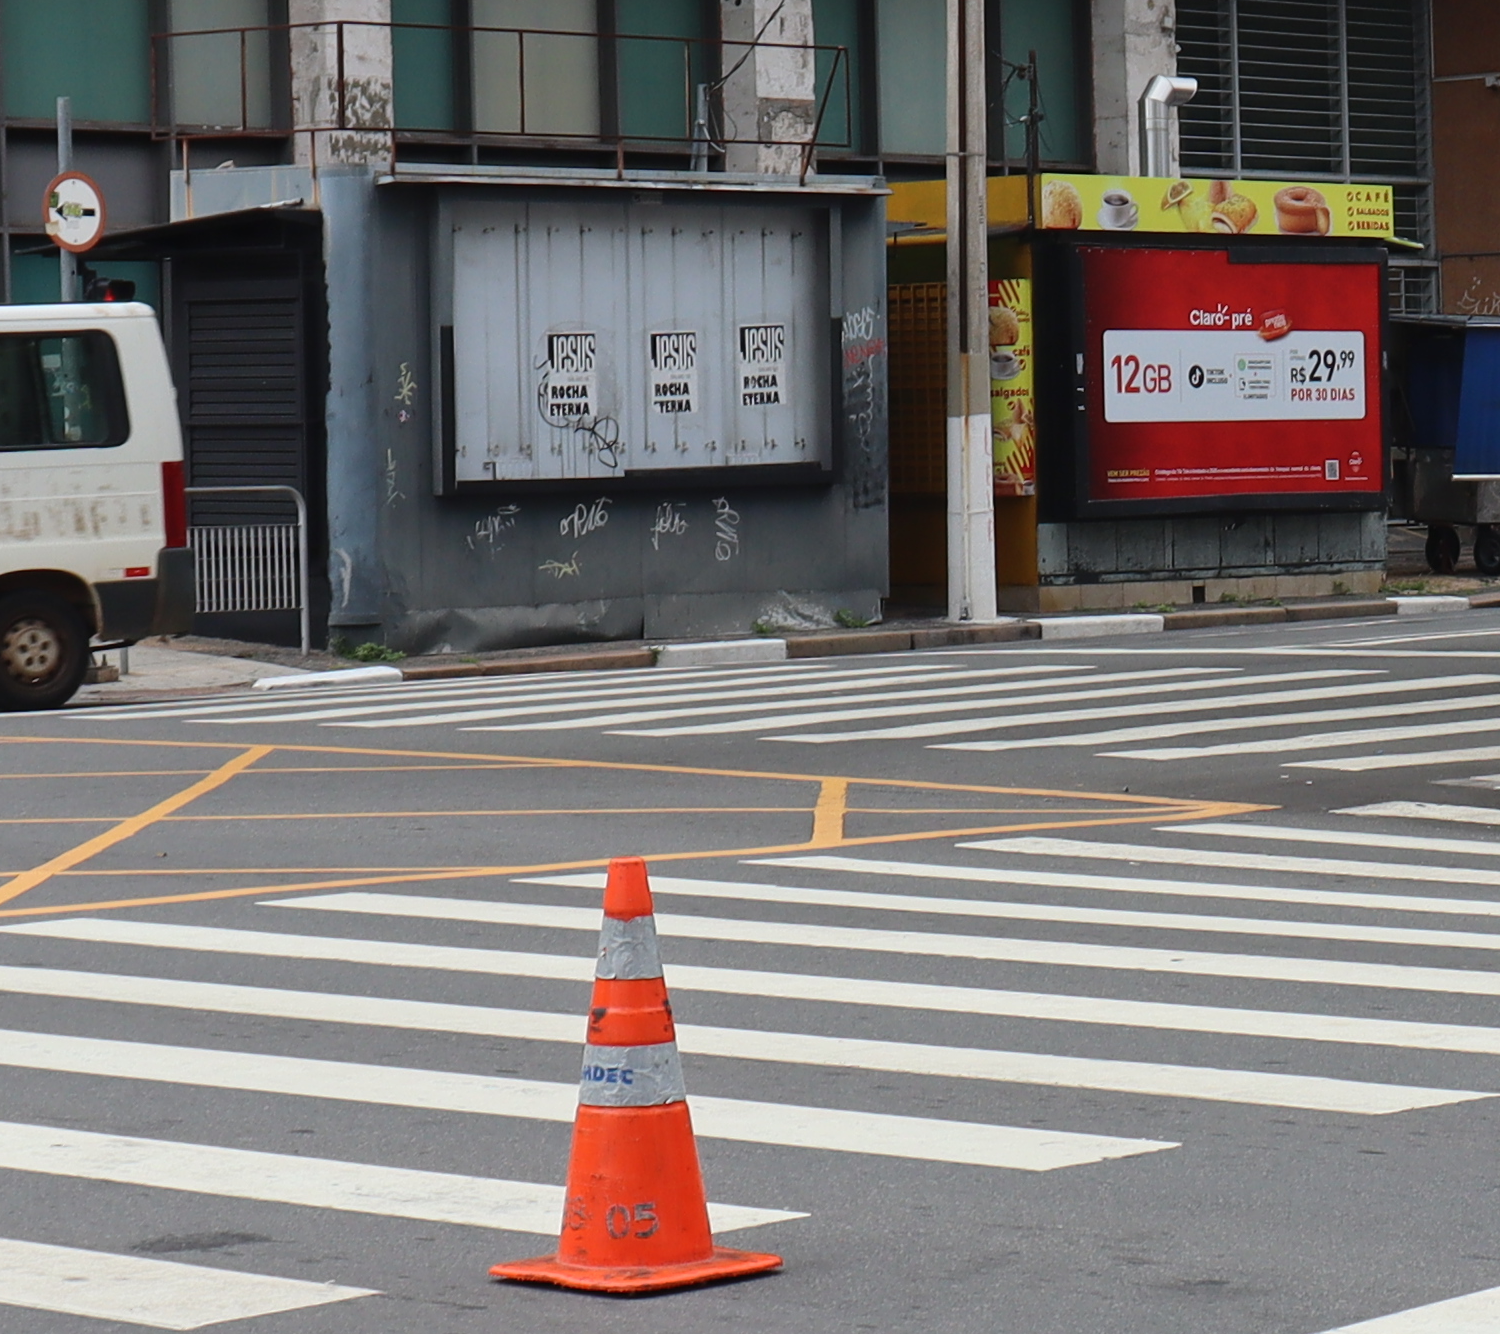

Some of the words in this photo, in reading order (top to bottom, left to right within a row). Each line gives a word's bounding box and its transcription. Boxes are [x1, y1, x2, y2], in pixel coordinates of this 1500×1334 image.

[1355, 190, 1389, 203] CAFÉ
[1190, 308, 1226, 326] Claro
[1231, 307, 1253, 329] pré
[744, 374, 778, 389] ROCHA
[1290, 367, 1307, 386] R$
[551, 385, 588, 399] ROCHA
[655, 382, 689, 397] ROCHA
[1291, 388, 1312, 401] POR
[1315, 388, 1328, 401] 30
[1331, 387, 1355, 401] DIAS
[742, 391, 780, 406] ETERNA
[550, 402, 590, 417] ETERNA
[605, 1201, 659, 1240] 05
